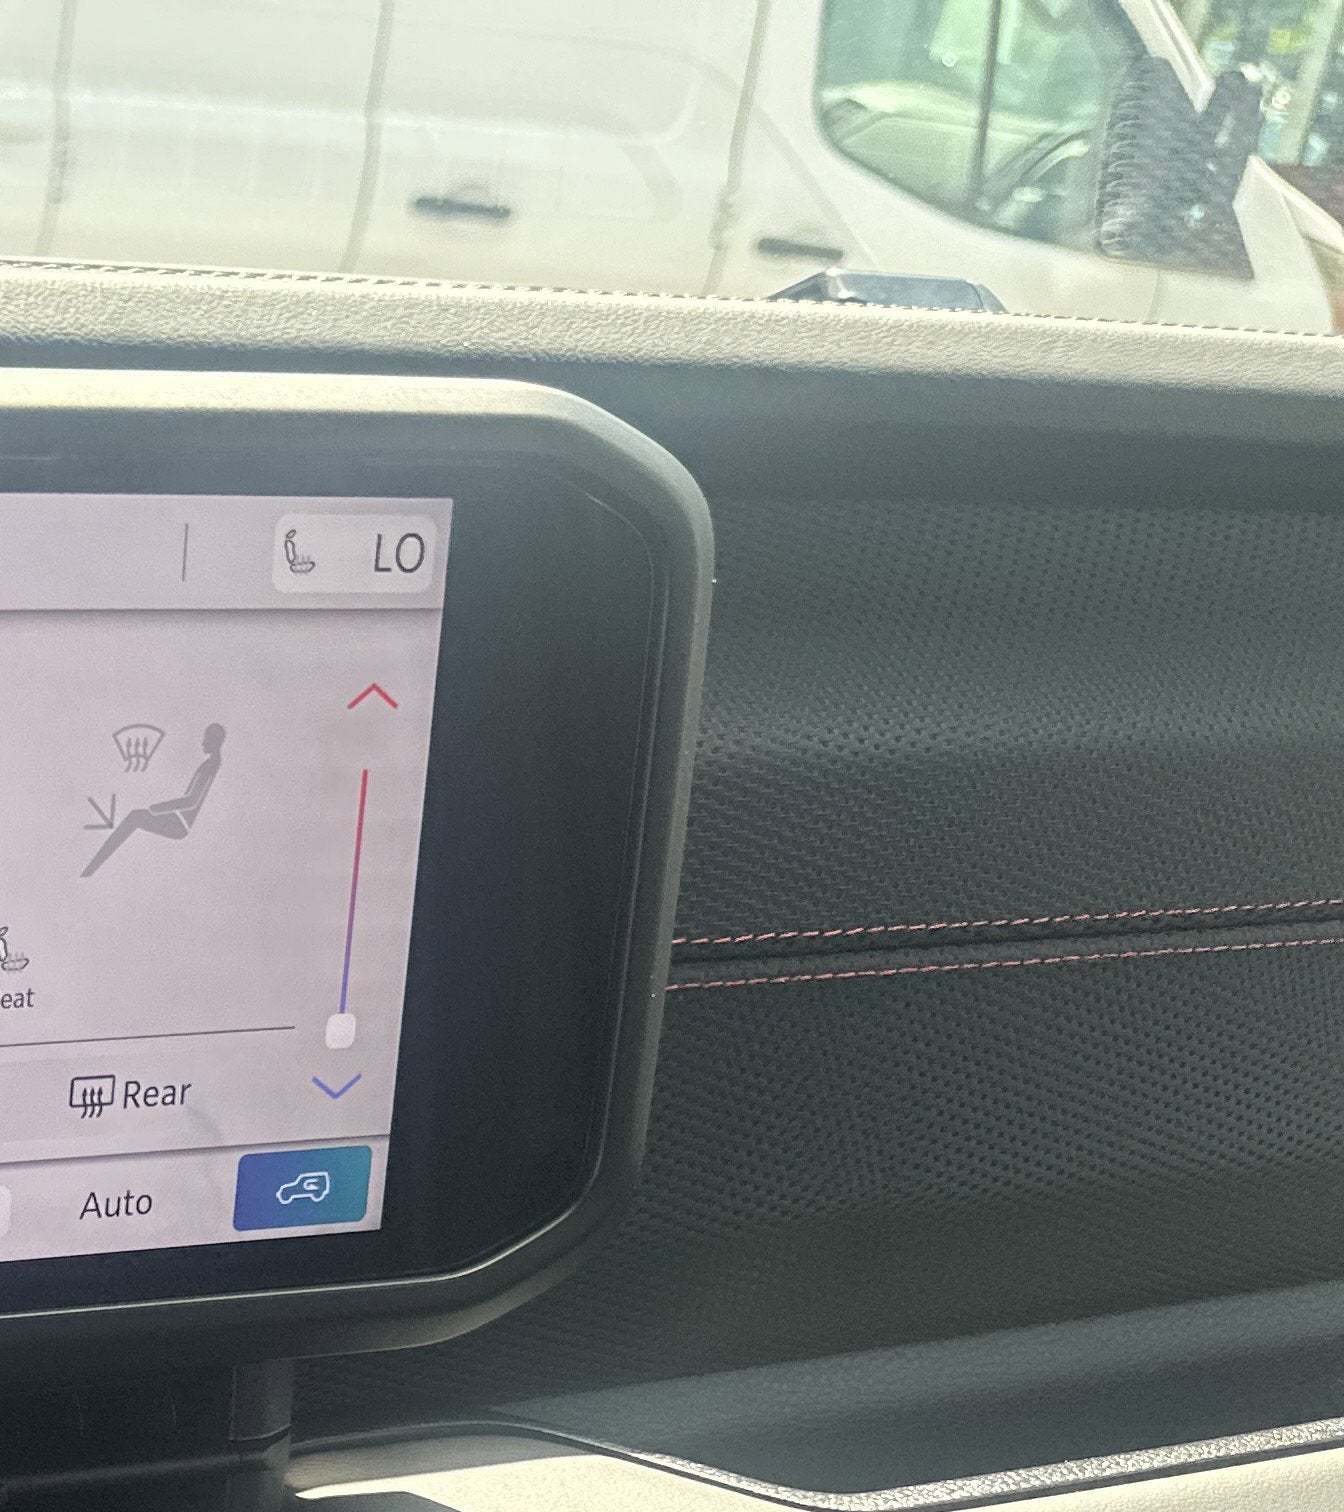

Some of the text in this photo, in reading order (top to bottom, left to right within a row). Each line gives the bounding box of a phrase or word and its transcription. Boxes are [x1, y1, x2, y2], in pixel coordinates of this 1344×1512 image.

[372, 531, 426, 574] LO
[122, 1078, 192, 1110] Rear
[78, 1189, 154, 1222] Auto
